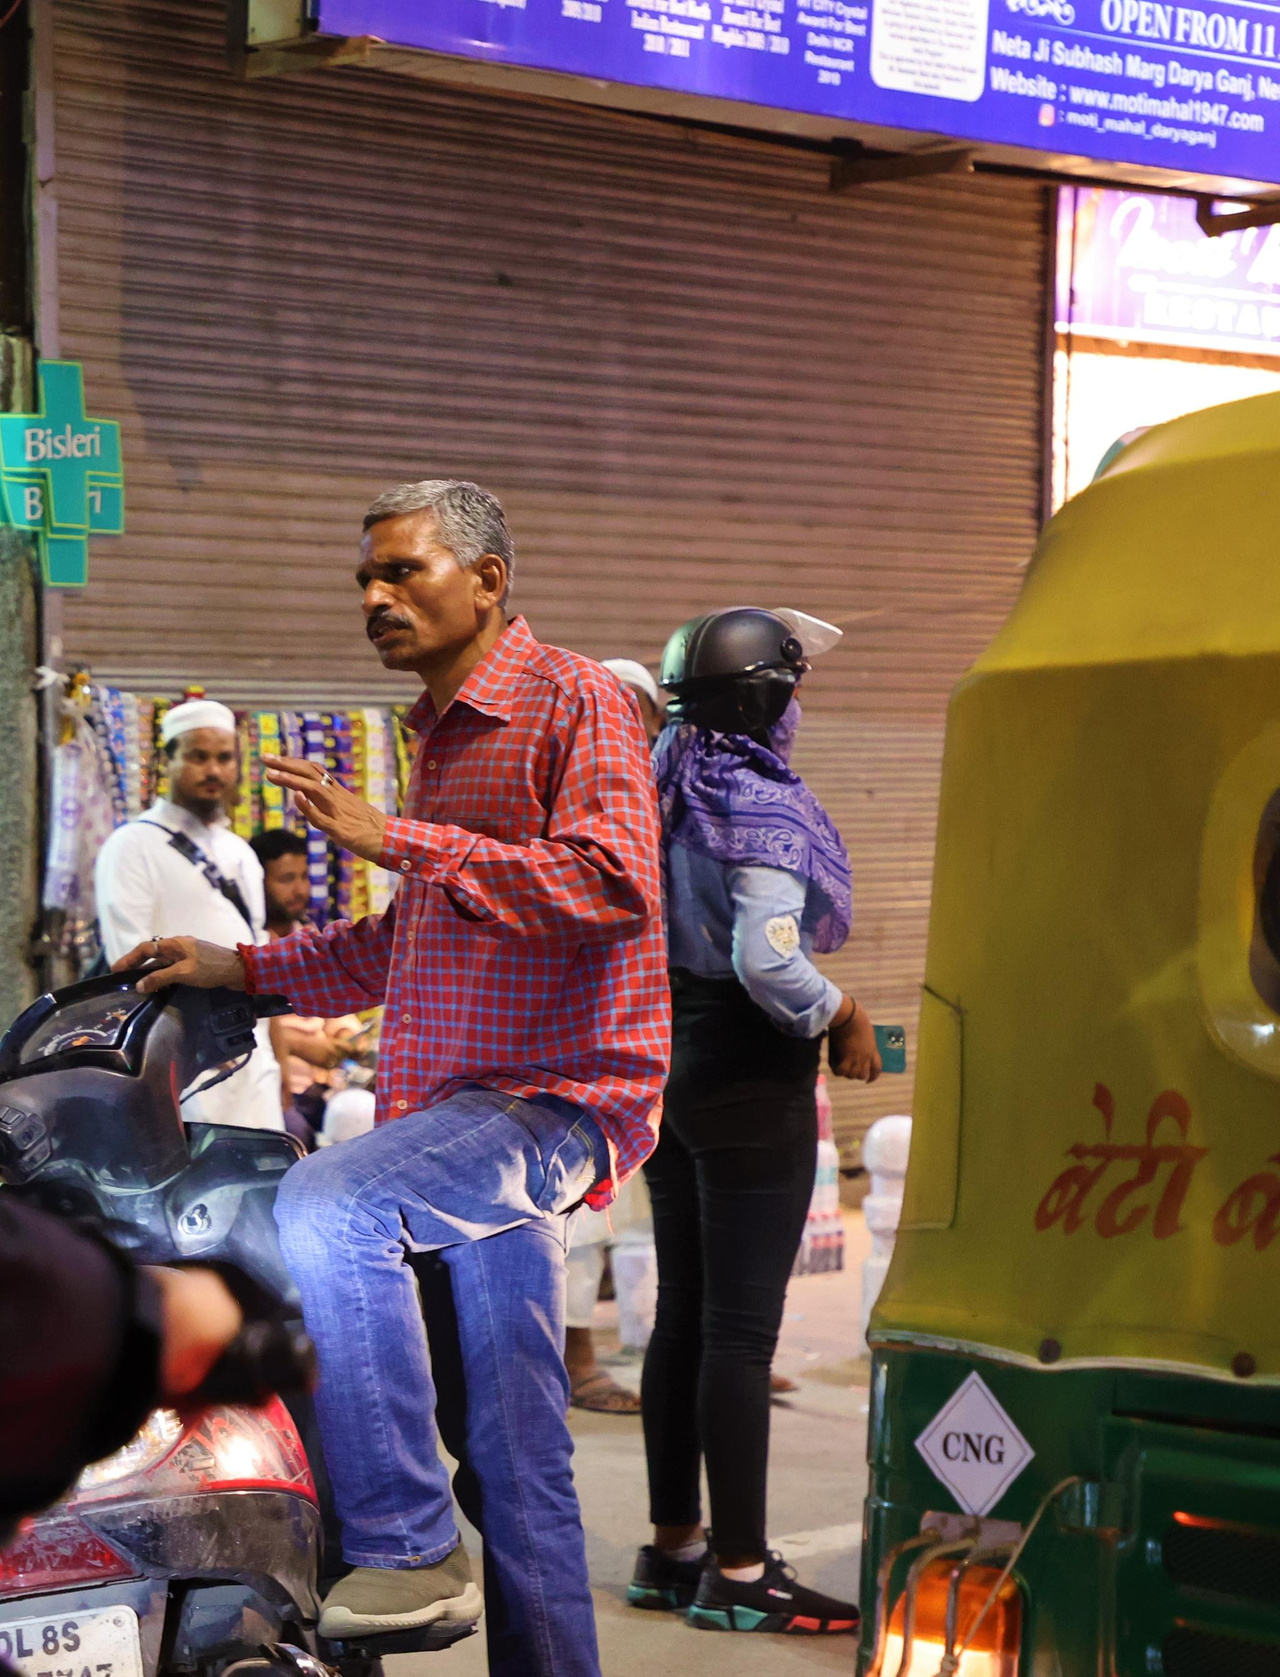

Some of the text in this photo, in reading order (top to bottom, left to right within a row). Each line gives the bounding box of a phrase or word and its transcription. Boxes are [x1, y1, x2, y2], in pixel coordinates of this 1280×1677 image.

[1100, 0, 1174, 40] OPEN
[1174, 6, 1249, 53] FROM
[991, 29, 1032, 60] Neta
[1032, 37, 1051, 63] Ji
[1051, 40, 1123, 76] Subhash
[1124, 53, 1166, 89] Marg
[1167, 60, 1214, 94] Darya
[989, 65, 1057, 101] Website
[1067, 84, 1265, 133] www.motimahal1947.com
[24, 423, 101, 462] Bisleri
[1034, 1081, 1211, 1241] बेटी
[942, 1431, 1005, 1466] CNG
[41, 1620, 81, 1656] 8S
